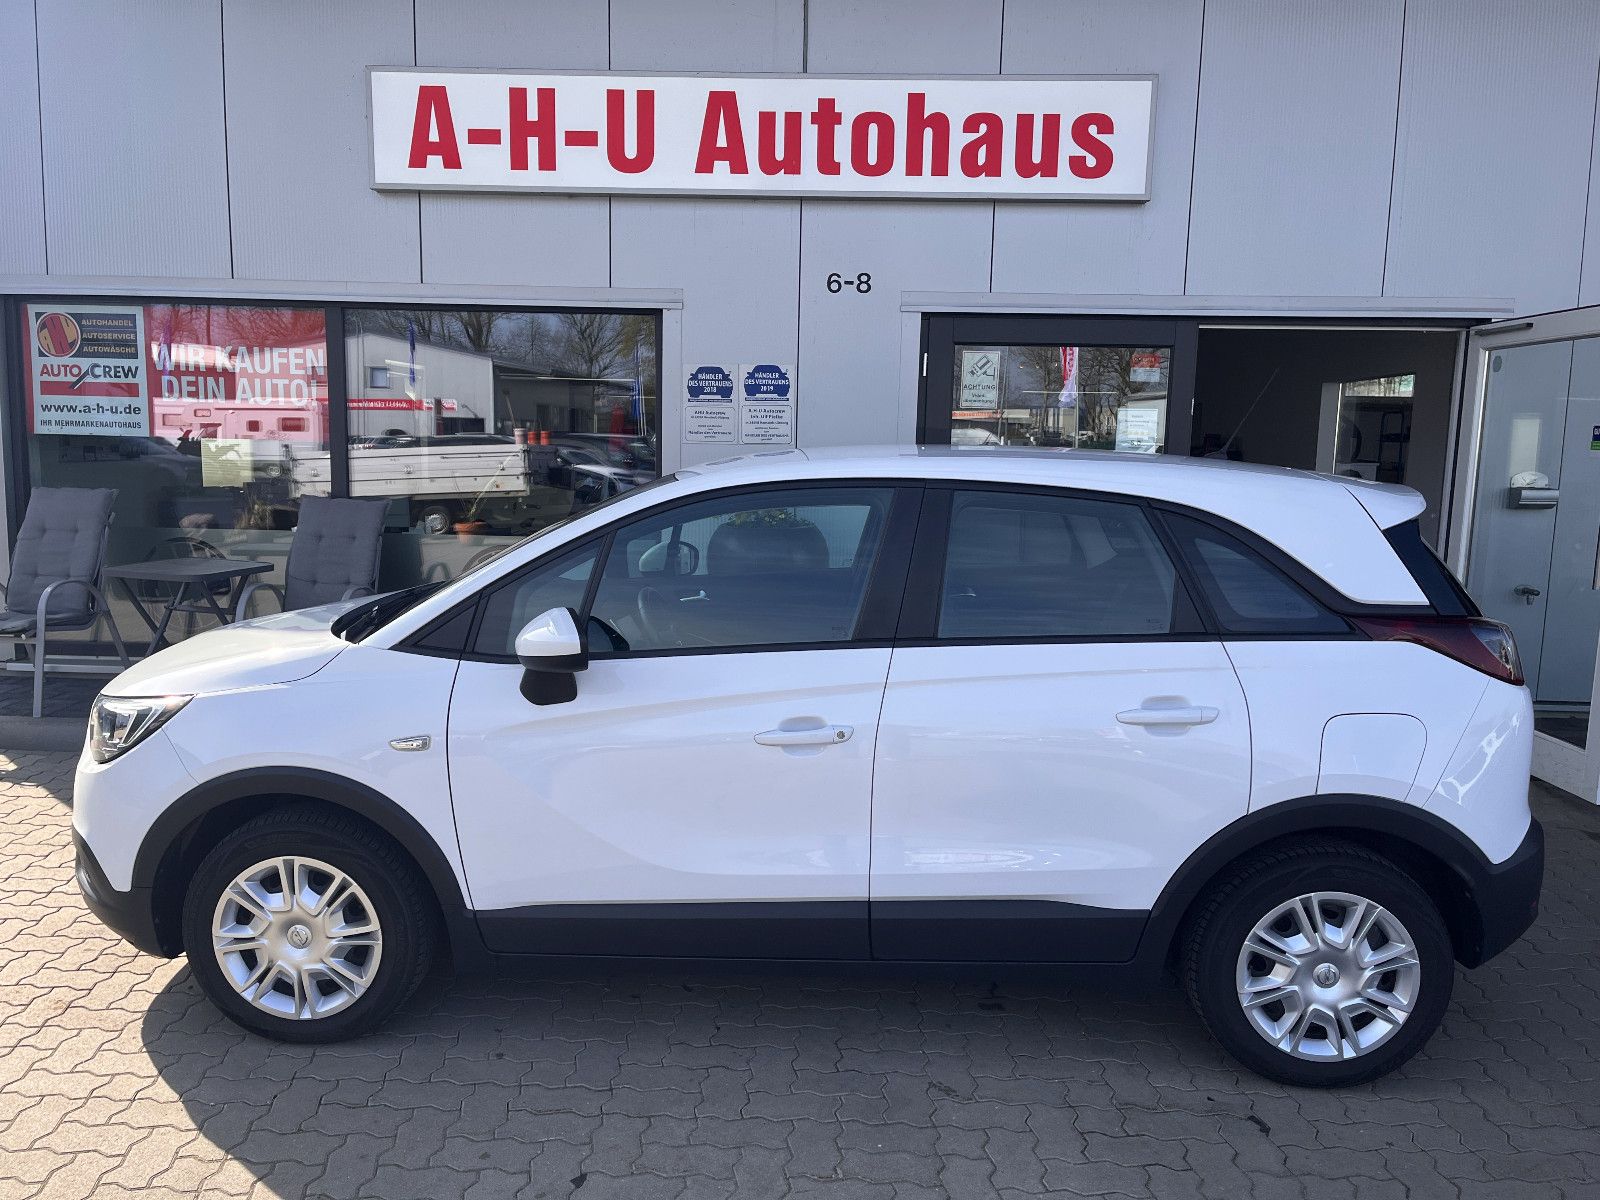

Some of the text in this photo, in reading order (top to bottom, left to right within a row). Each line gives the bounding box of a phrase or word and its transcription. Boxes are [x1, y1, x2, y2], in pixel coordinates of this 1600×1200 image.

[408, 85, 1114, 179] A-H-U Autohaus
[826, 272, 872, 294] 6-8
[81, 319, 133, 327] AUTOHANDEL
[83, 345, 136, 354] AUTOWÄSCHE
[151, 343, 326, 376] WIR KAUFEN
[40, 362, 139, 379] AUTO CREW
[697, 372, 723, 380] HÄNDLER
[754, 371, 780, 379] HÄNDLER
[161, 375, 318, 407] DEIN AUTO!
[963, 383, 996, 391] ACHTUNG
[40, 403, 142, 415] www.a-h-u.de
[40, 419, 142, 429] IHR MEHRMARKENAUTOHAUS
